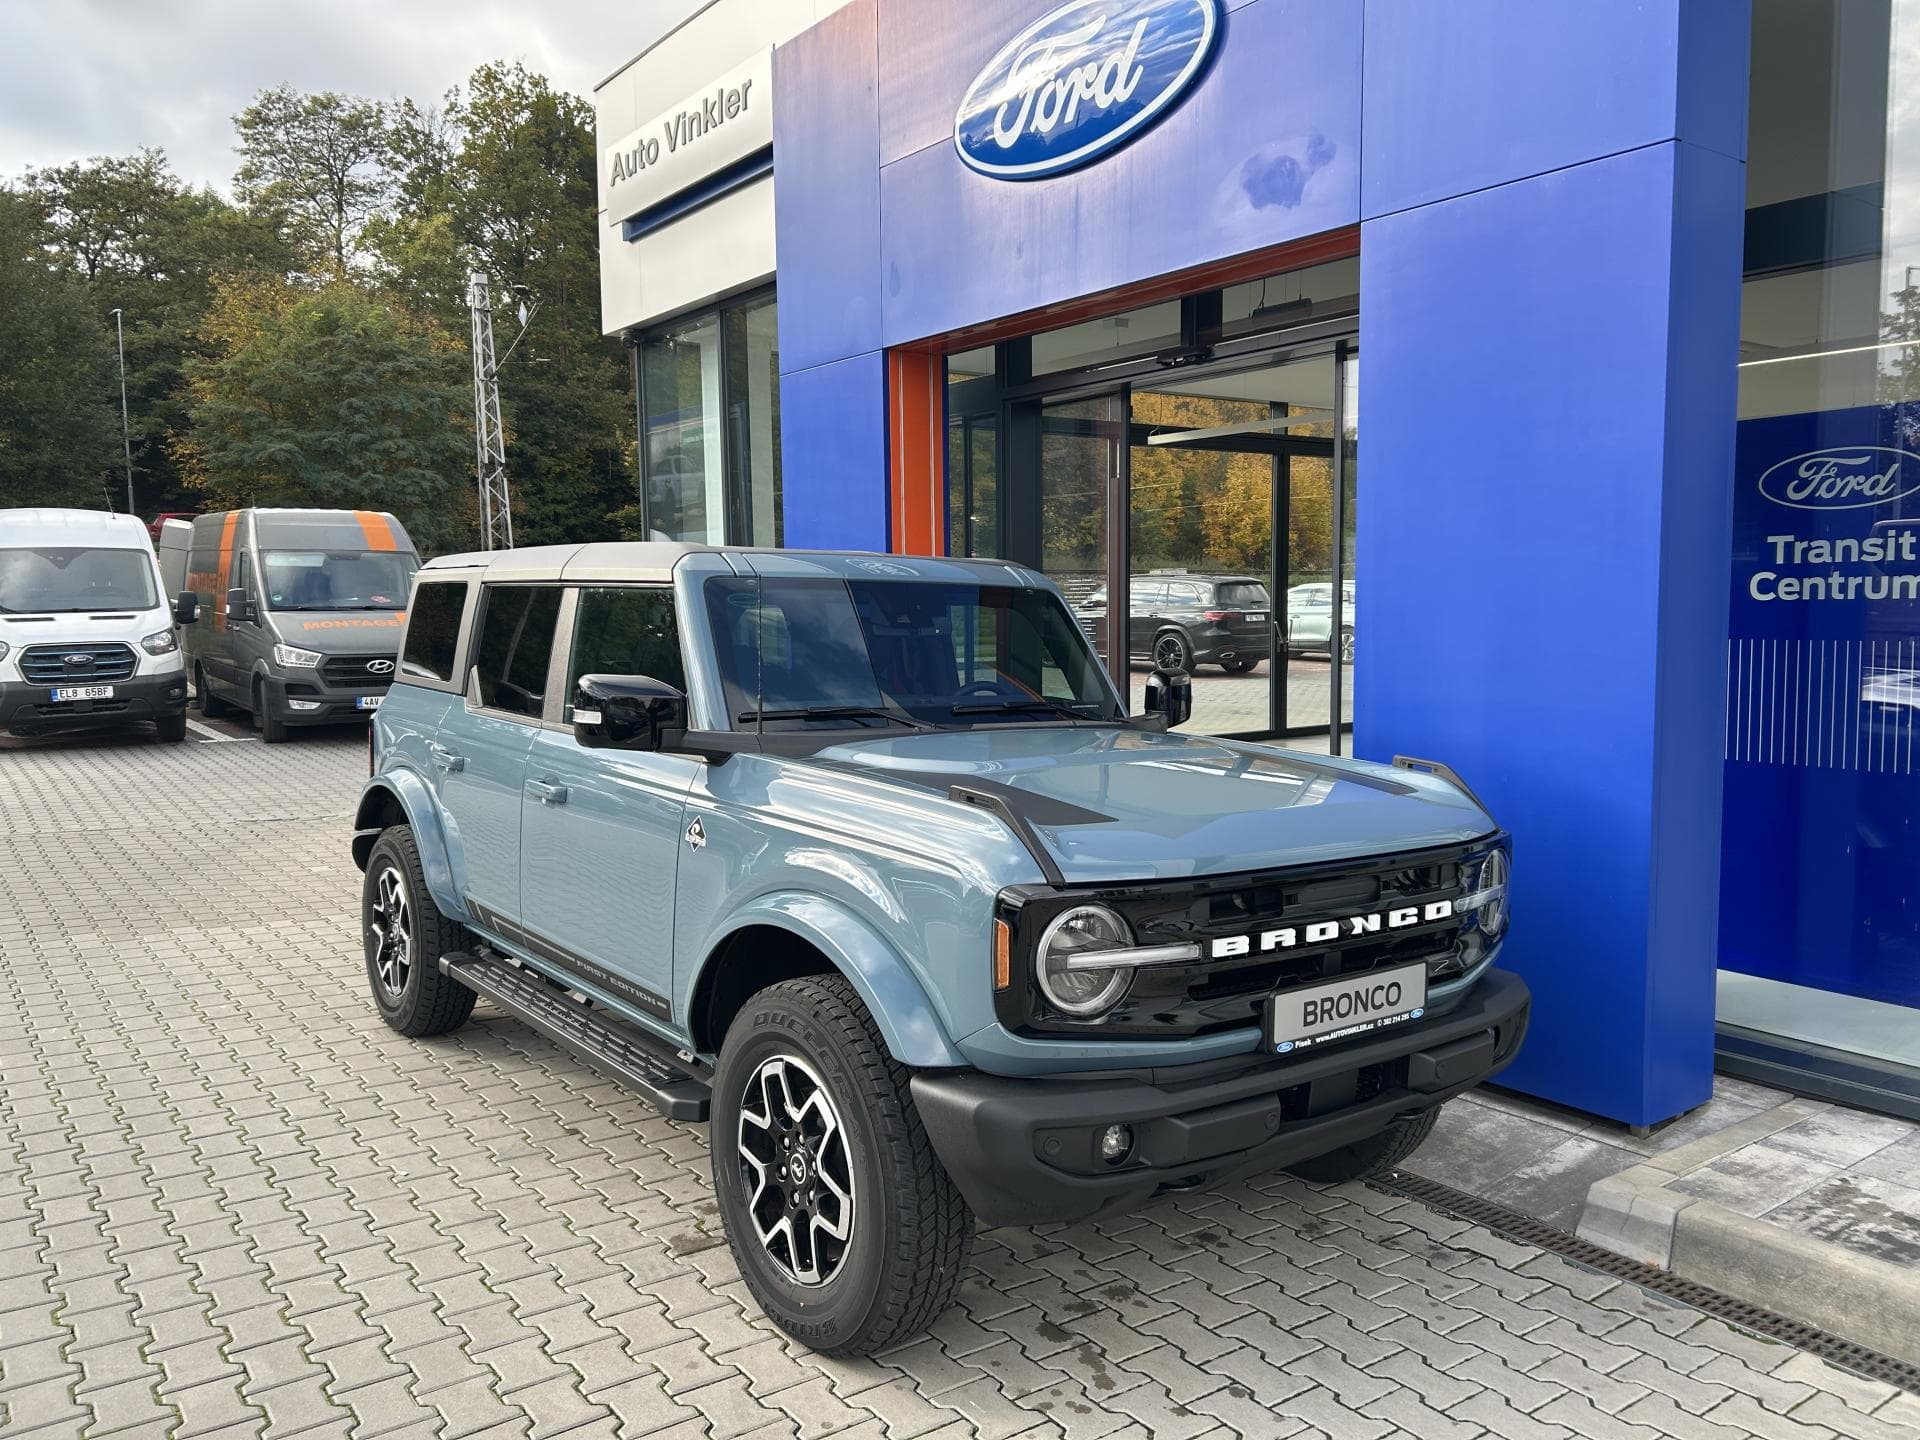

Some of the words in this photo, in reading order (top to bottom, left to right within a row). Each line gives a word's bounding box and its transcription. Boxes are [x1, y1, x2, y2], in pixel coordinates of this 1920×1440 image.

[993, 14, 1150, 149] Ford
[610, 136, 659, 187] Auto
[664, 79, 752, 153] Vinkler
[1786, 455, 1900, 501] Ford
[1767, 529, 1917, 565] Transit
[1749, 571, 1920, 601] Centrum
[60, 689, 77, 698] EL8
[85, 687, 108, 697] 65BF
[1211, 900, 1453, 958] BRONCO
[576, 959, 607, 980] FIRST
[609, 976, 656, 1006] EDITION
[1303, 981, 1402, 1028] BRONCO
[753, 1011, 853, 1105] DUELER
